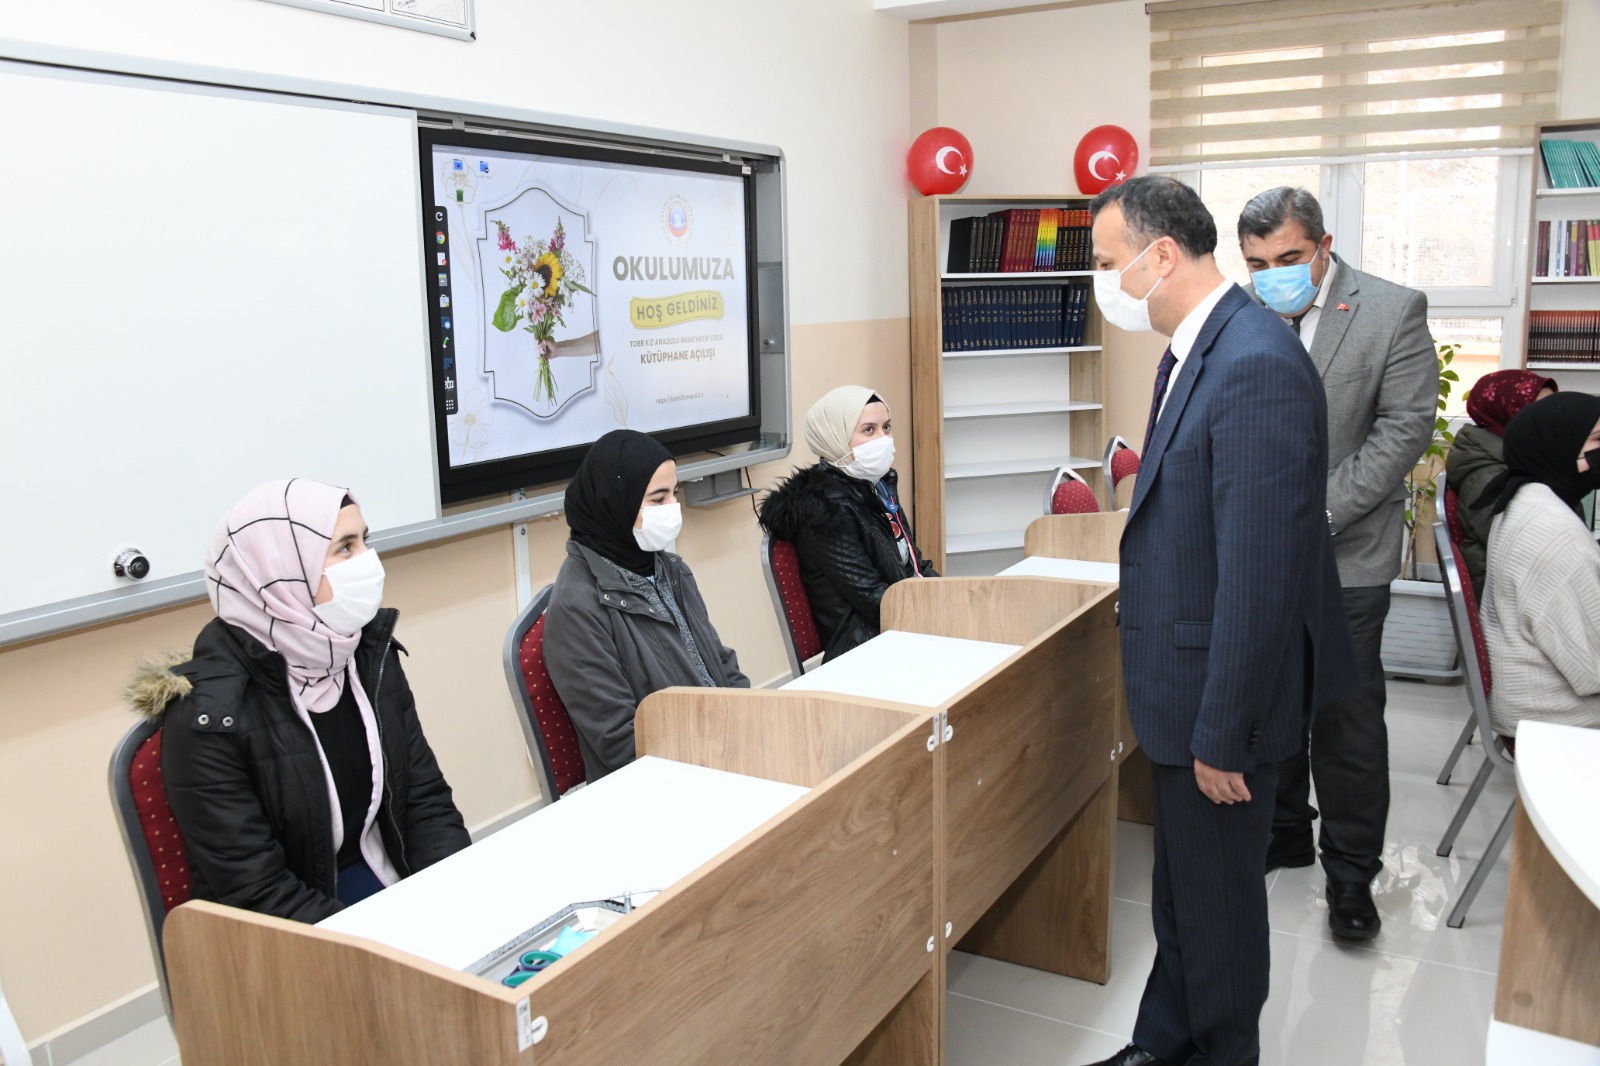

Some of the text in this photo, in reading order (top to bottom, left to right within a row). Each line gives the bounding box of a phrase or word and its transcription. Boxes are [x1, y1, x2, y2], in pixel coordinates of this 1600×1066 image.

[612, 255, 735, 281] OKULUMUZA
[636, 295, 718, 322] HOŞ GELDİNİZ
[630, 340, 645, 348] TOBB
[655, 337, 680, 346] ANADOLU
[640, 348, 715, 364] KÜTÜPHANE AÇILIŞI
